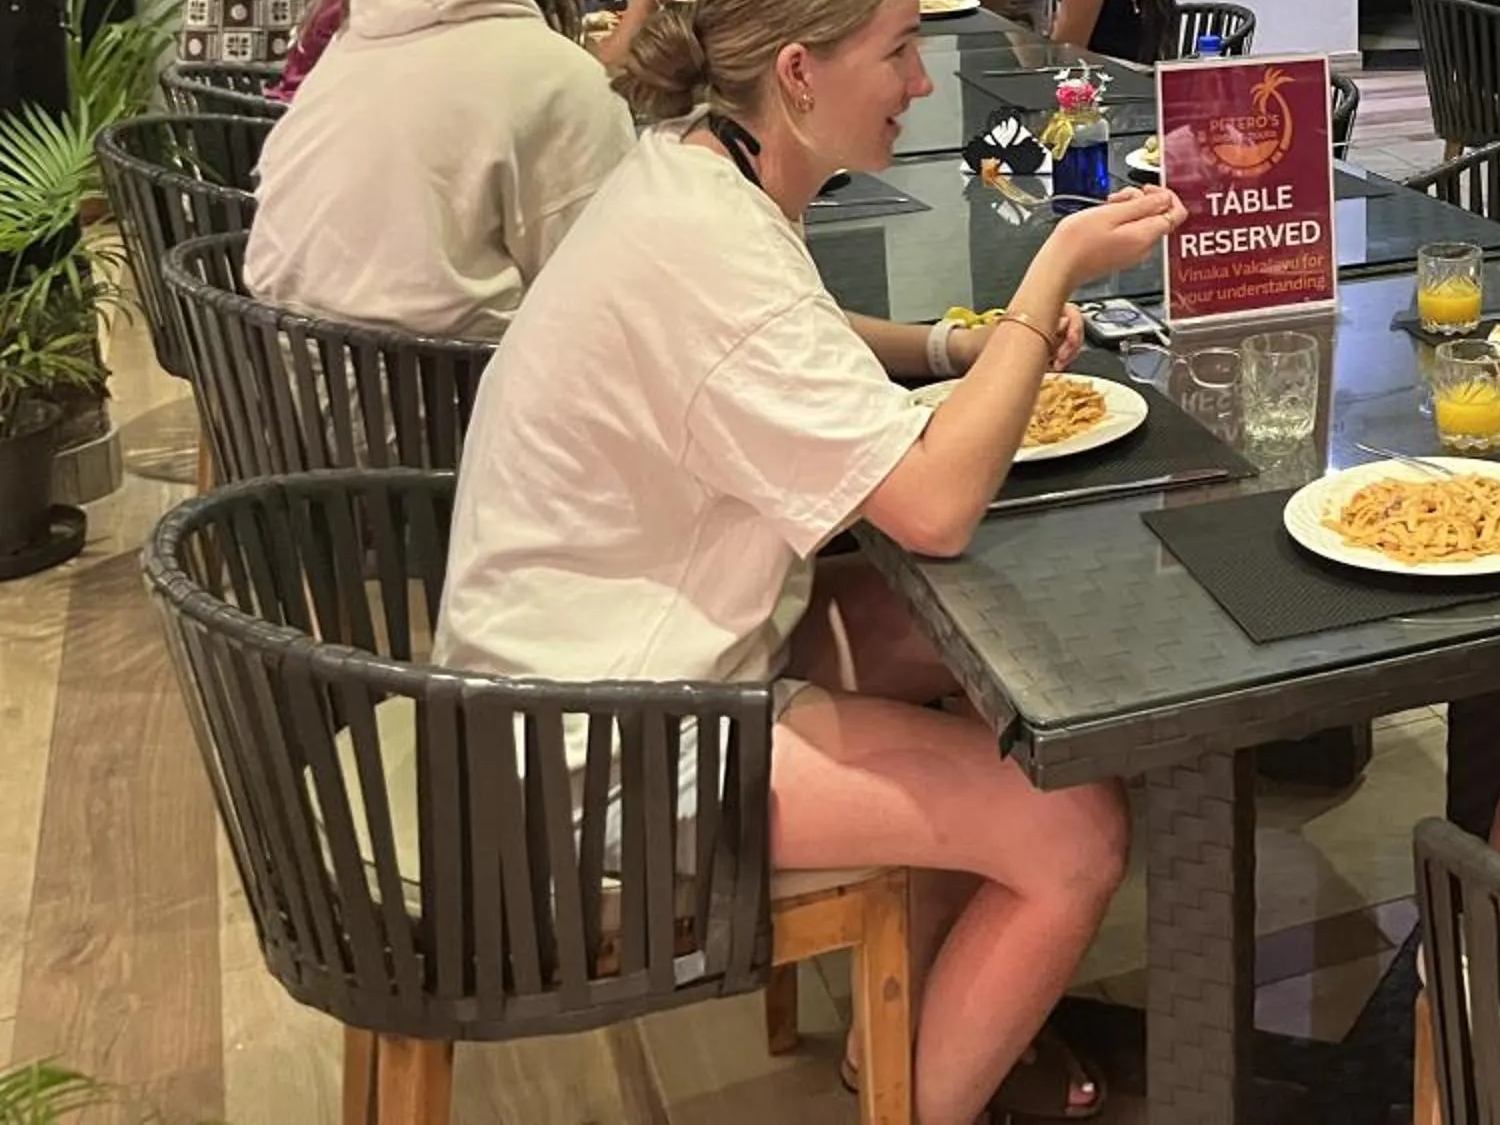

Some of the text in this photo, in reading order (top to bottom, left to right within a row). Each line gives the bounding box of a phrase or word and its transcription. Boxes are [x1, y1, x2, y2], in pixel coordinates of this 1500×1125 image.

[1205, 185, 1294, 217] TABLE
[1180, 220, 1321, 258] RESERVED
[1301, 253, 1324, 269] for
[1216, 274, 1326, 301] understanding
